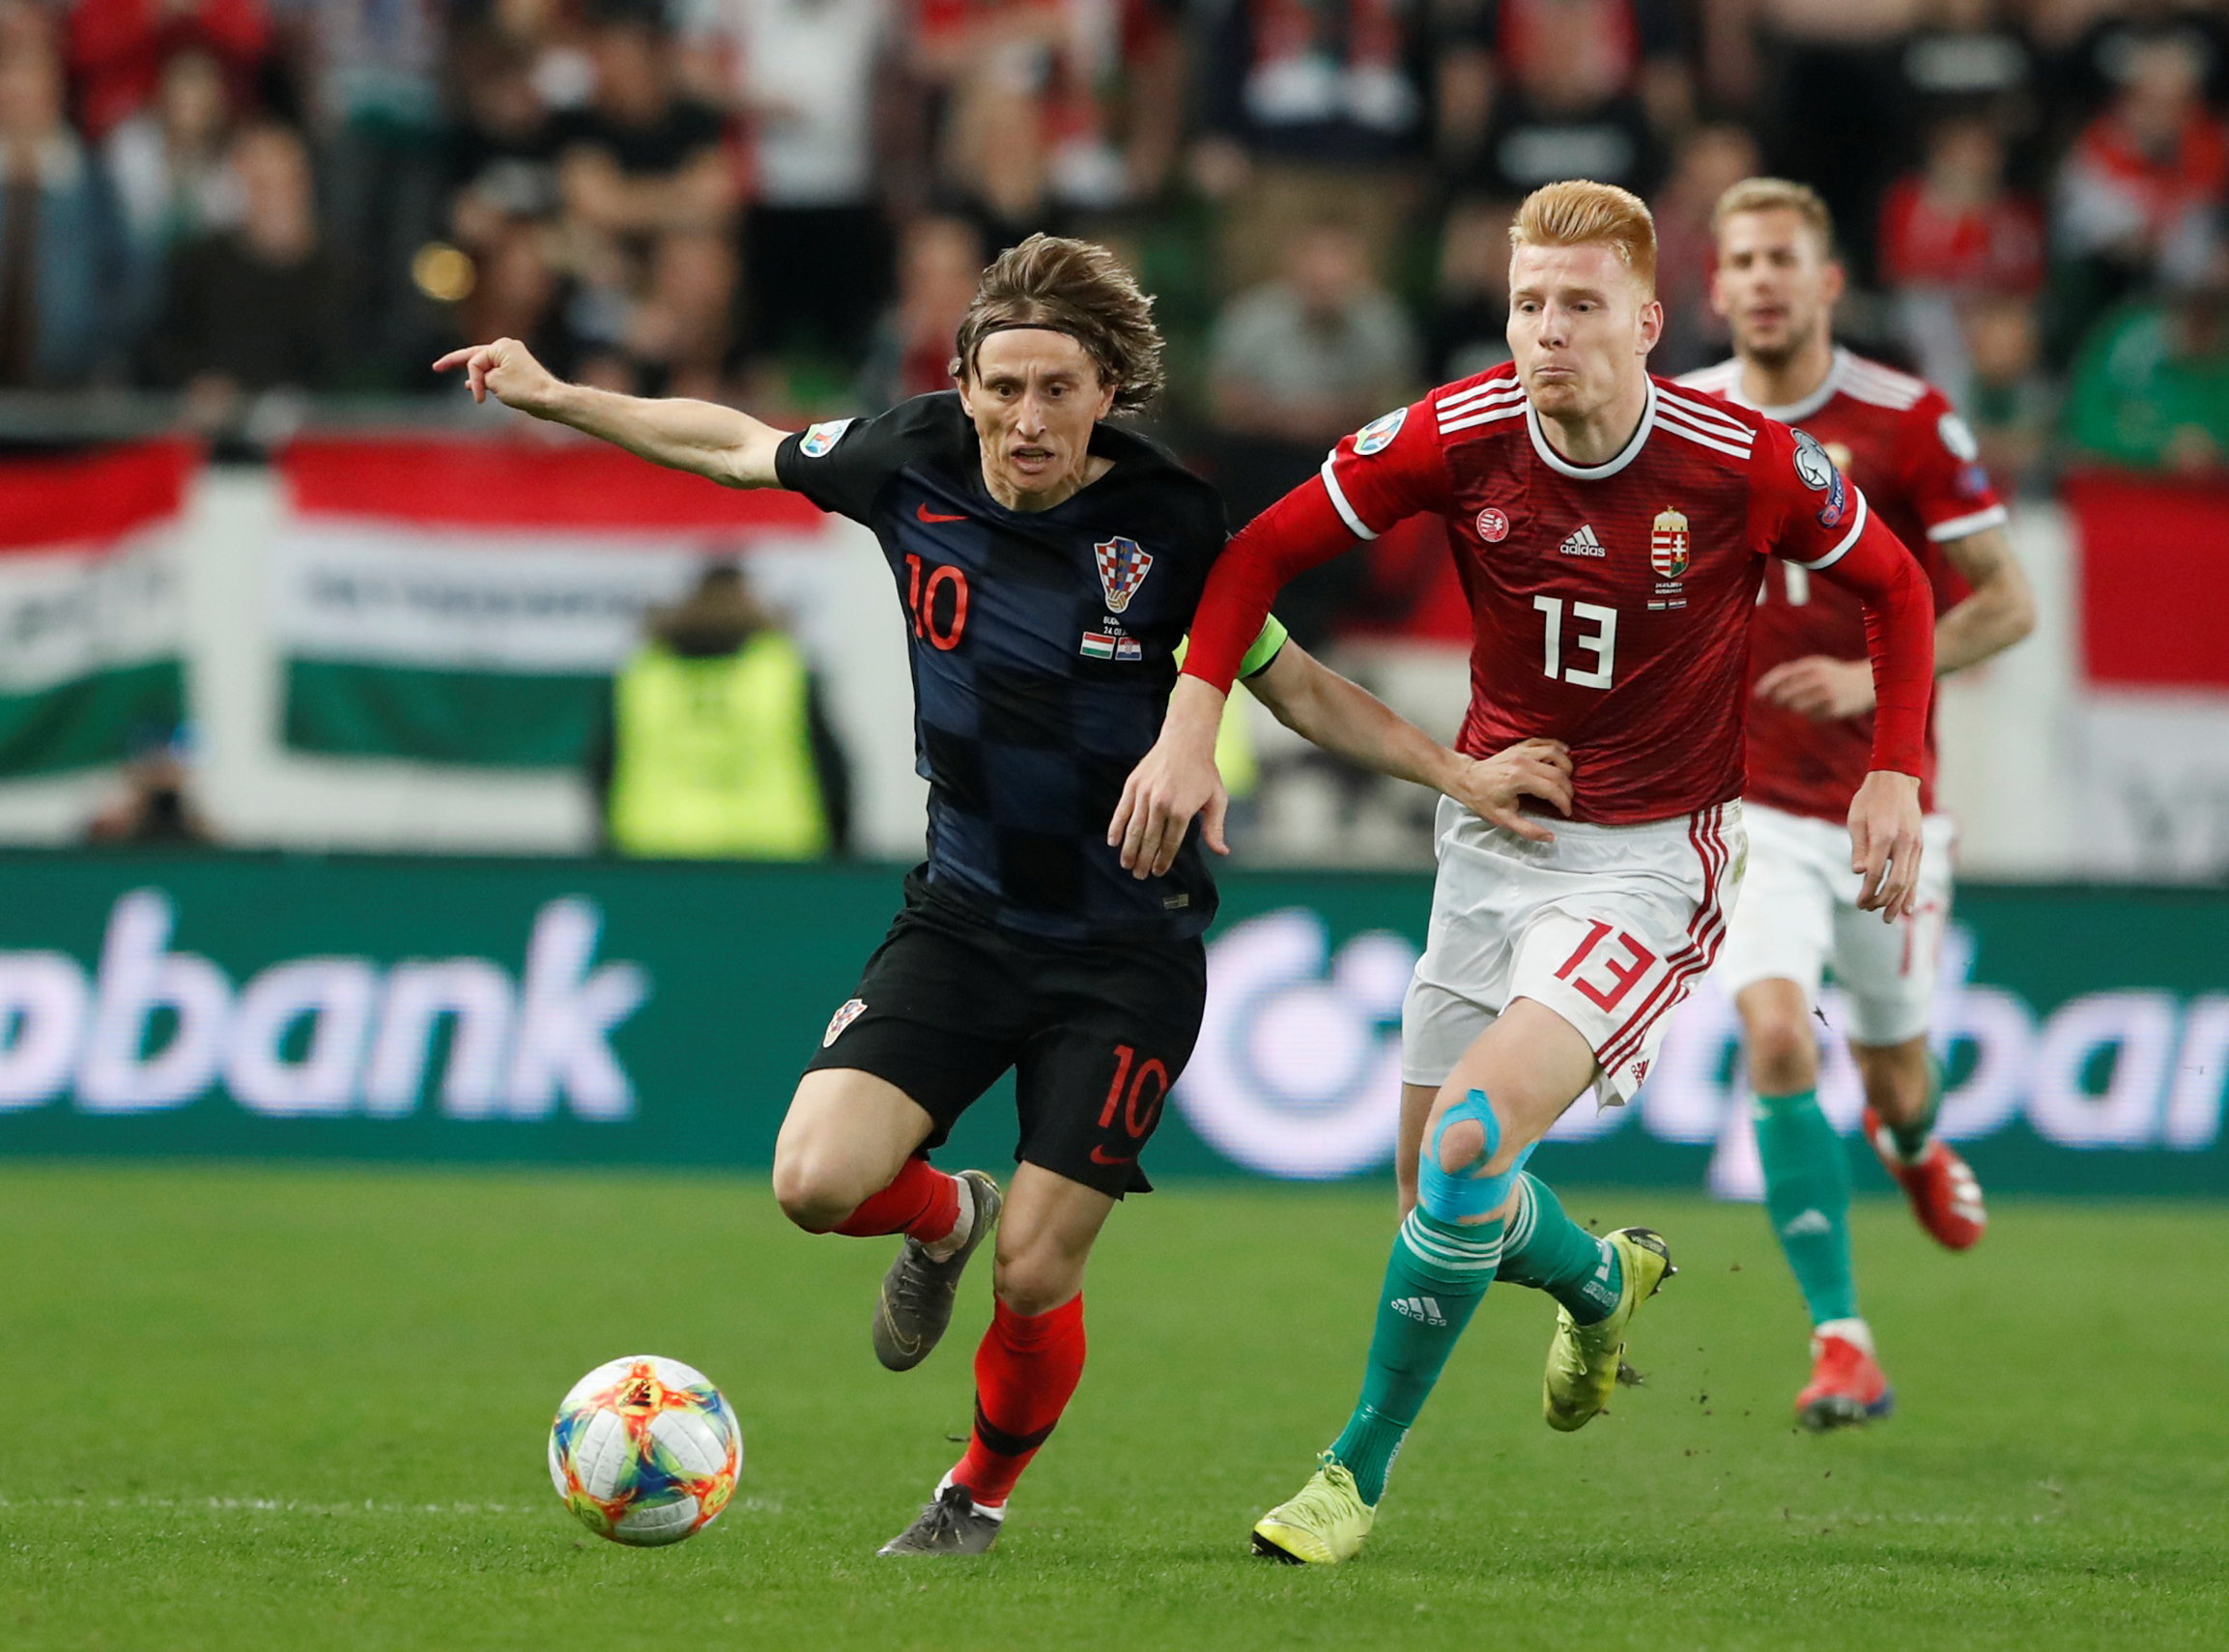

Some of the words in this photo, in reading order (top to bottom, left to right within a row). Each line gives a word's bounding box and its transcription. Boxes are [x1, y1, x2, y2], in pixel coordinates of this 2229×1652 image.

[1559, 543, 1606, 558] adidas
[905, 553, 968, 650] 10
[1533, 594, 1618, 690] 13
[1553, 918, 1657, 1013] 13
[1098, 1044, 1168, 1138] 10
[1390, 1299, 1447, 1327] adidas
